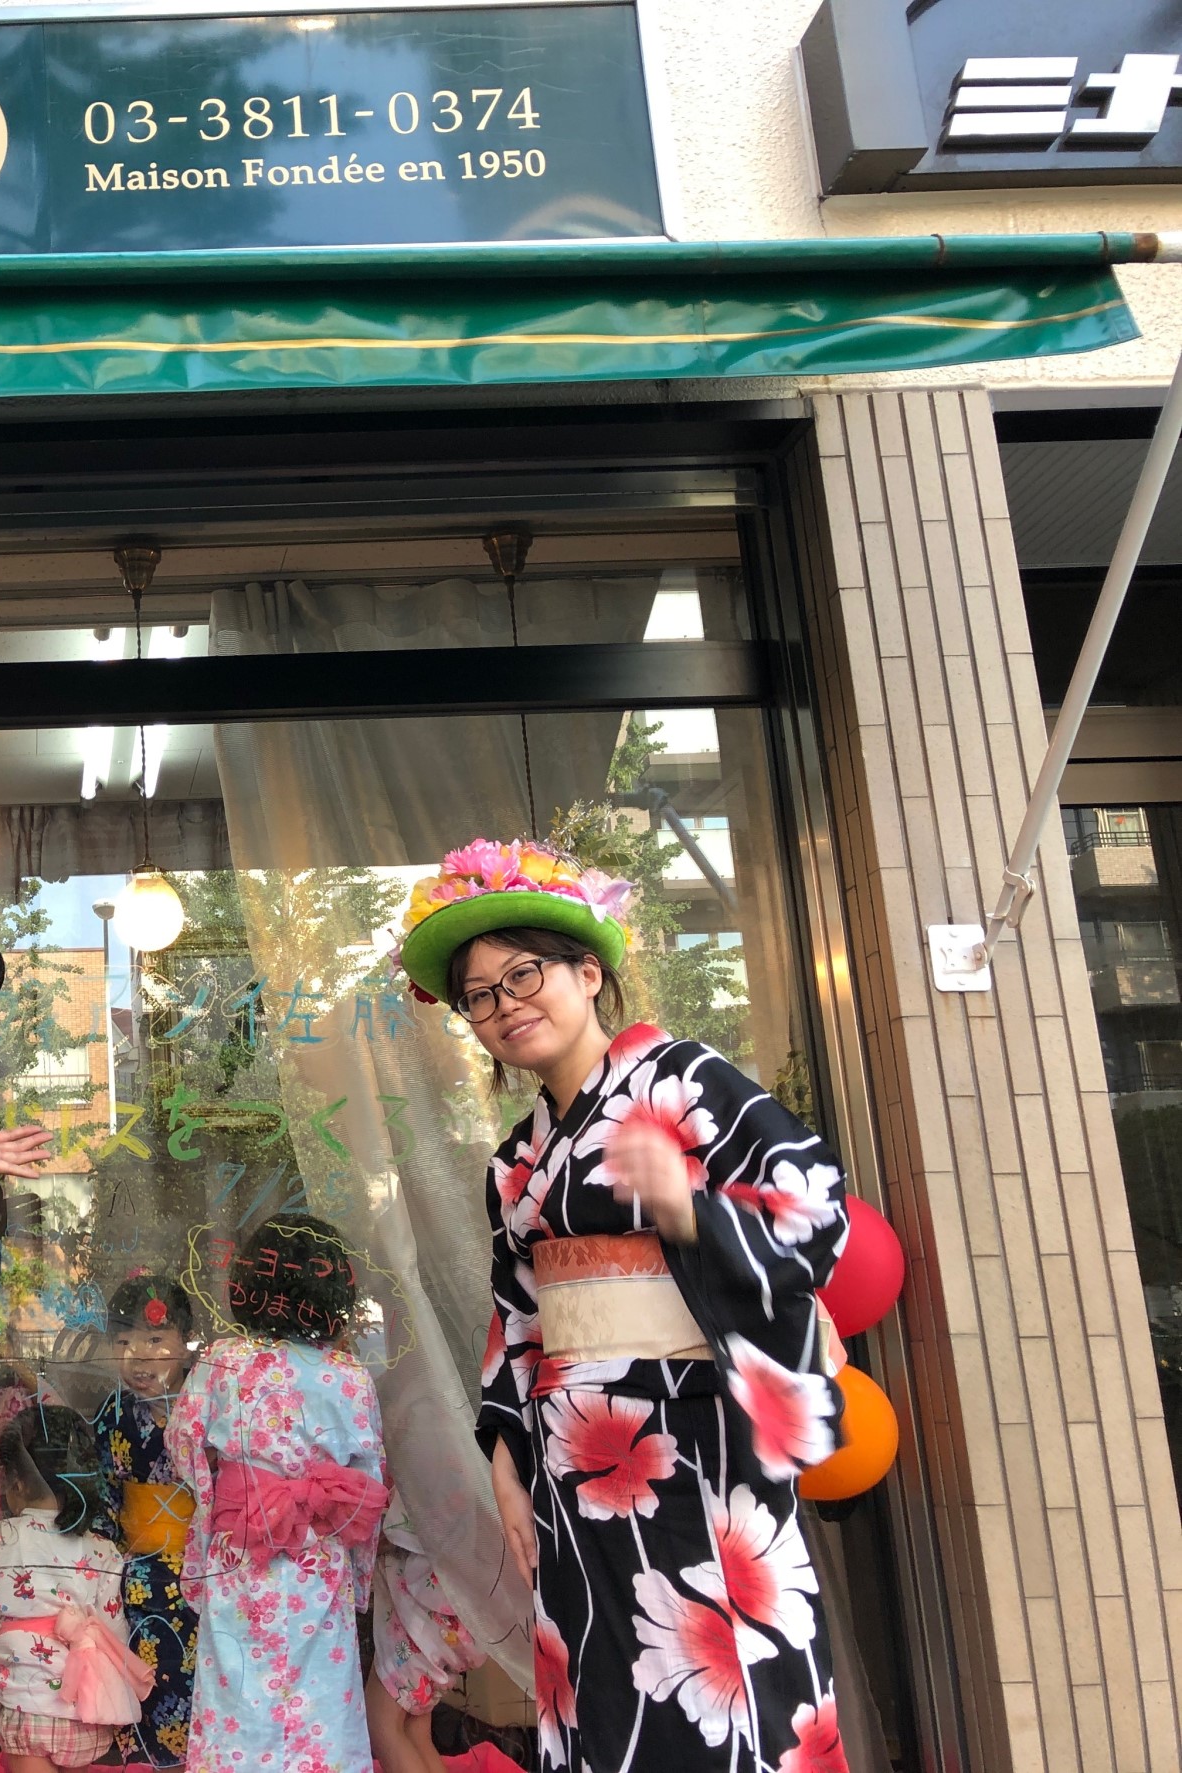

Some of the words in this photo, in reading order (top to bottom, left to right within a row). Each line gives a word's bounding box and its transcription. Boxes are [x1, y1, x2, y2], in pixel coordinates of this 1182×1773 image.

[84, 87, 541, 144] 03-3811-0374
[84, 162, 230, 192] Maison
[242, 153, 385, 186] Fondée
[398, 161, 446, 182] en
[458, 149, 546, 180] 1950
